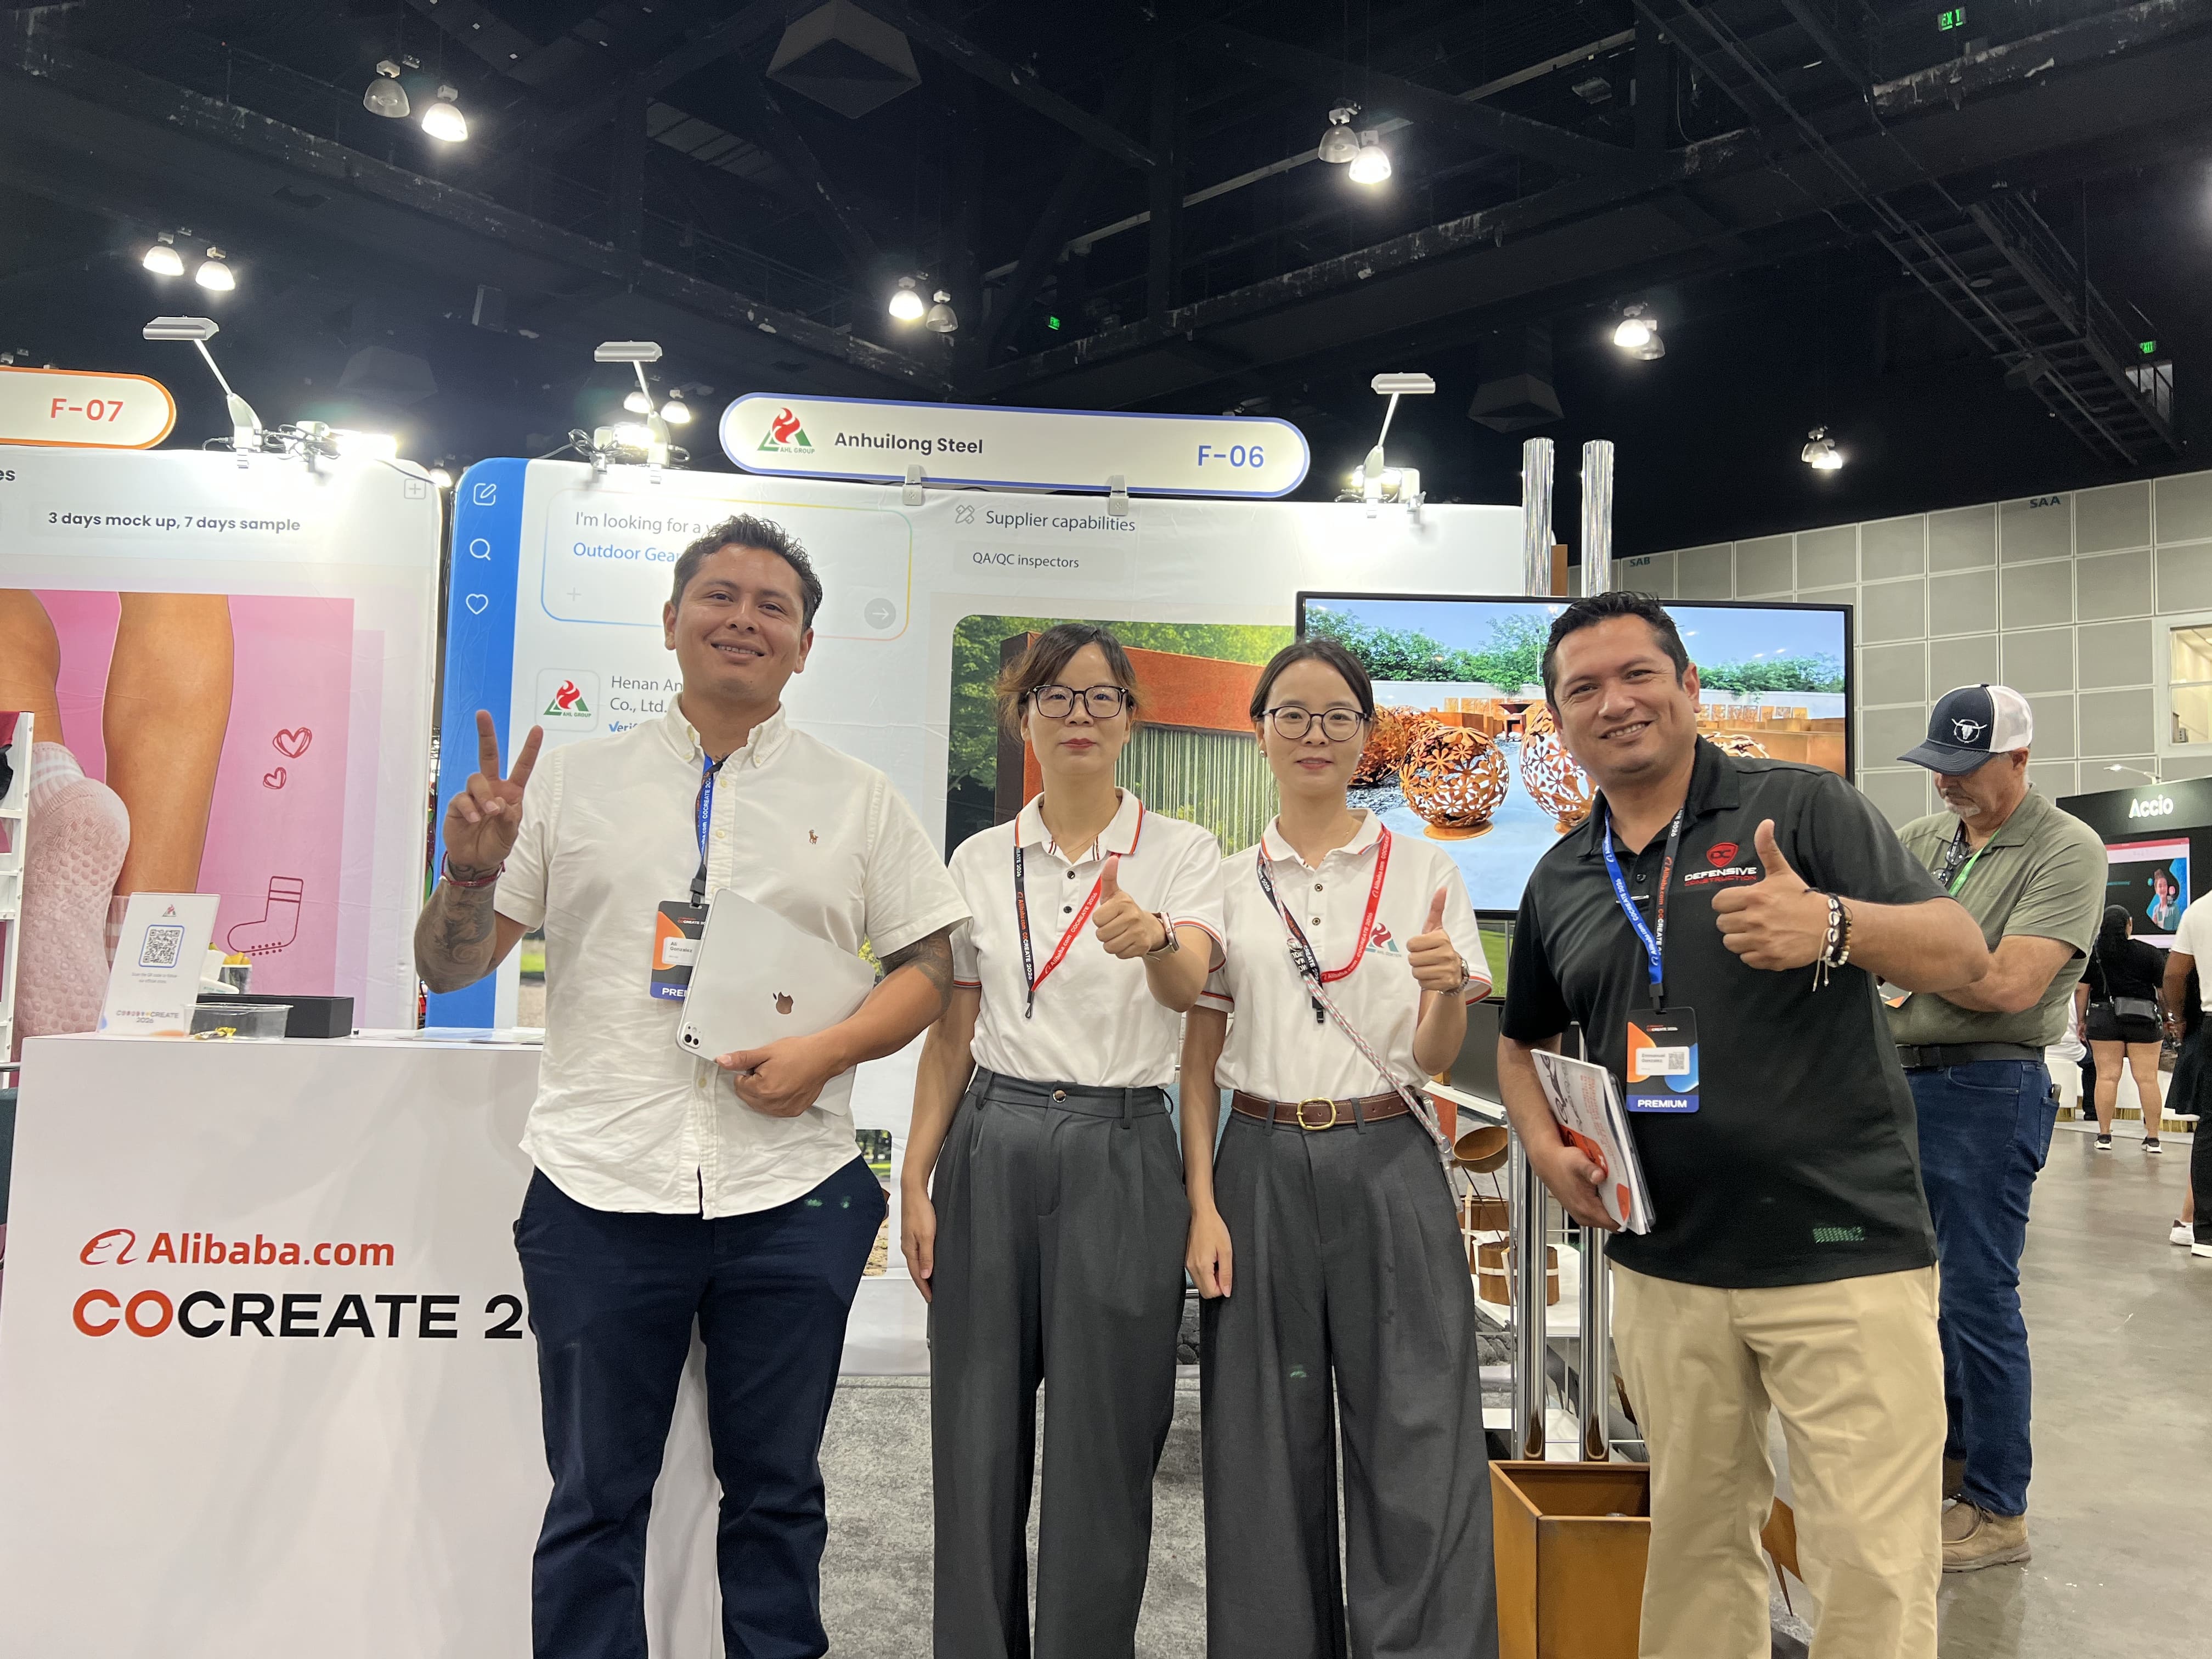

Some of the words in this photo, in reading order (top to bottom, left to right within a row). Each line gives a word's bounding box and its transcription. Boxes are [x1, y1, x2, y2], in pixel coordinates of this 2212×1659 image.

[50, 397, 125, 422] F-07
[834, 432, 933, 456] Anhuilong
[937, 438, 983, 454] Steel
[1198, 445, 1264, 468] F-06
[2030, 495, 2061, 509] SAA
[48, 512, 58, 524] 3
[61, 512, 101, 529] days
[105, 515, 152, 527] mock
[155, 517, 180, 531] up,
[184, 516, 193, 528] 7
[196, 516, 236, 532] days
[240, 518, 301, 534] sample
[575, 511, 598, 527] I'm
[603, 513, 662, 534] looking
[667, 517, 689, 533] for
[692, 523, 701, 534] a
[986, 510, 1048, 529] Supplier
[1052, 515, 1136, 532] capabilities
[573, 542, 641, 560] Outdoor
[973, 552, 1015, 566] QA/QC
[1018, 555, 1079, 569] inspectors
[1629, 556, 1651, 568] SAB
[611, 675, 658, 691] Henan
[663, 679, 683, 692] An
[610, 697, 636, 713] Co.,
[641, 699, 668, 713] Ltd.
[702, 789, 710, 819] COCREATE
[2128, 794, 2174, 819] Accio
[1671, 820, 1680, 837] 2026
[1261, 878, 1271, 892] 2026
[1373, 861, 1385, 890] Alibaba.com
[1658, 867, 1670, 905] Alibaba.com
[1684, 867, 1757, 882] DEFENSIVE
[1684, 875, 1758, 887] CONSTRUCTION
[1620, 893, 1639, 922] COCREATE
[1018, 899, 1026, 931] Alibaba.com
[1022, 932, 1031, 963] COCREATE
[1050, 934, 1073, 966] Alibaba.com
[1070, 906, 1090, 933] COCREATE
[1087, 892, 1098, 906] 2026
[1637, 923, 1657, 955] Alibaba.com
[1656, 909, 1664, 946] COCREATE
[1328, 960, 1358, 979] Alibaba.com
[1356, 924, 1369, 958] COCREATE
[662, 987, 687, 997] PRE
[1637, 1099, 1688, 1108] PREMIUM
[146, 1232, 395, 1267] Alibaba.com
[72, 1289, 461, 1339] COCREATE
[484, 1294, 523, 1339] 2
